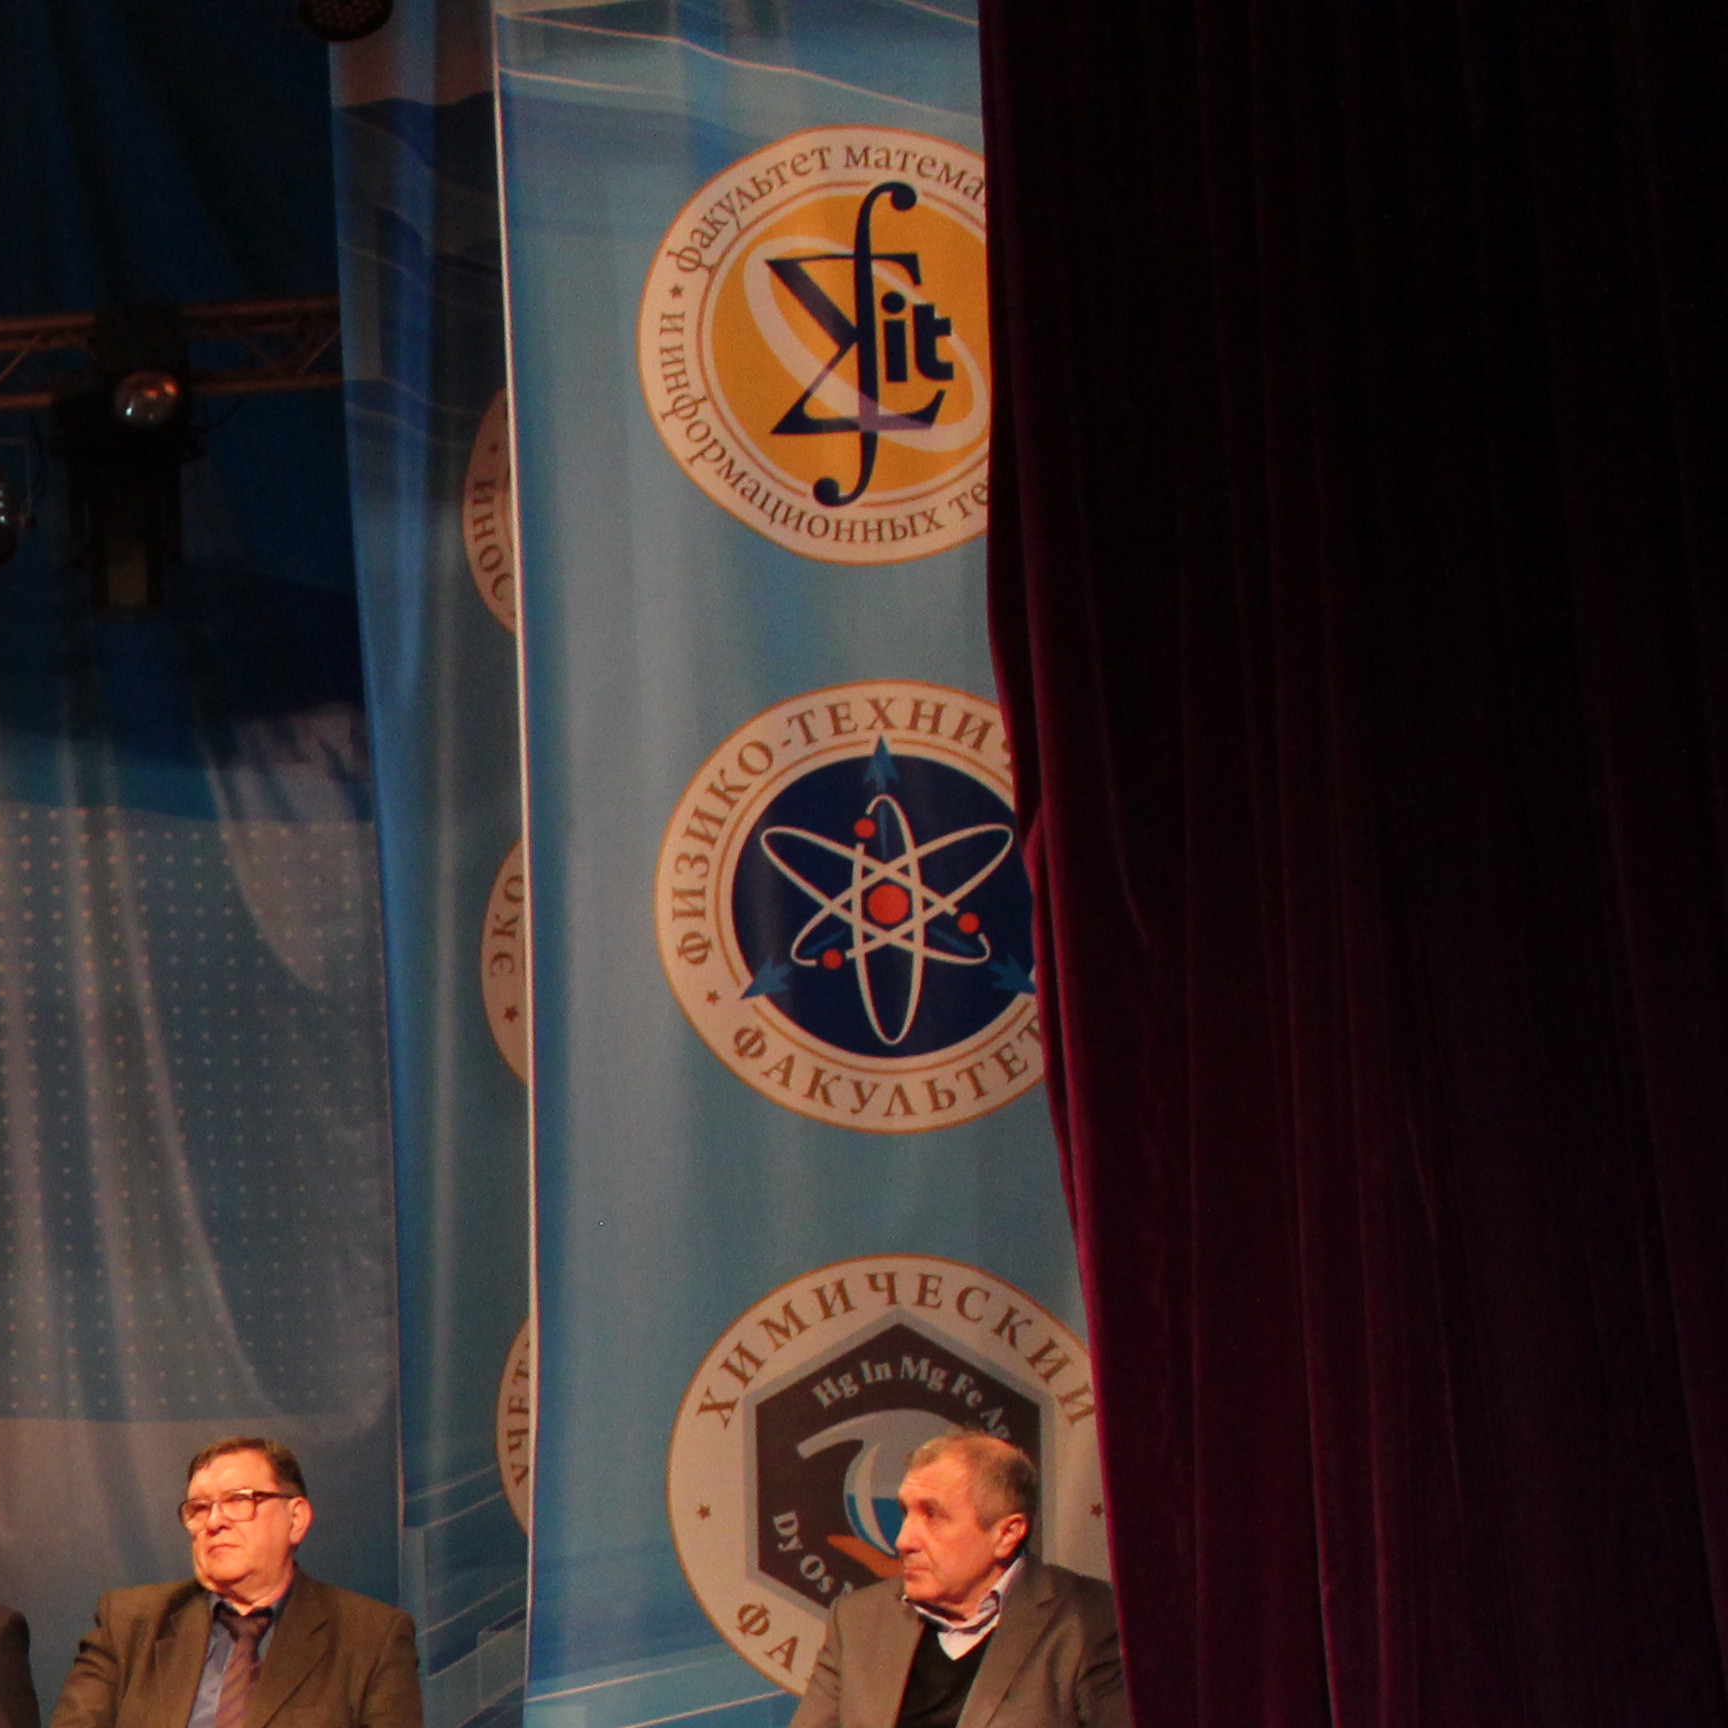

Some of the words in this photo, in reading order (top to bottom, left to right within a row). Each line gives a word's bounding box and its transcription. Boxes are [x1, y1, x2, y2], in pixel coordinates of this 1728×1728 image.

[666, 145, 832, 273] факультет
[845, 145, 986, 205] матема
[660, 349, 944, 543] информационных
[947, 476, 988, 518] те
[671, 697, 1014, 966] ФИЗИКО-ТЕХНИ
[811, 1372, 860, 1408] Hg
[860, 1359, 893, 1384] In
[899, 1355, 949, 1392] Mg
[950, 1372, 984, 1408] Fe
